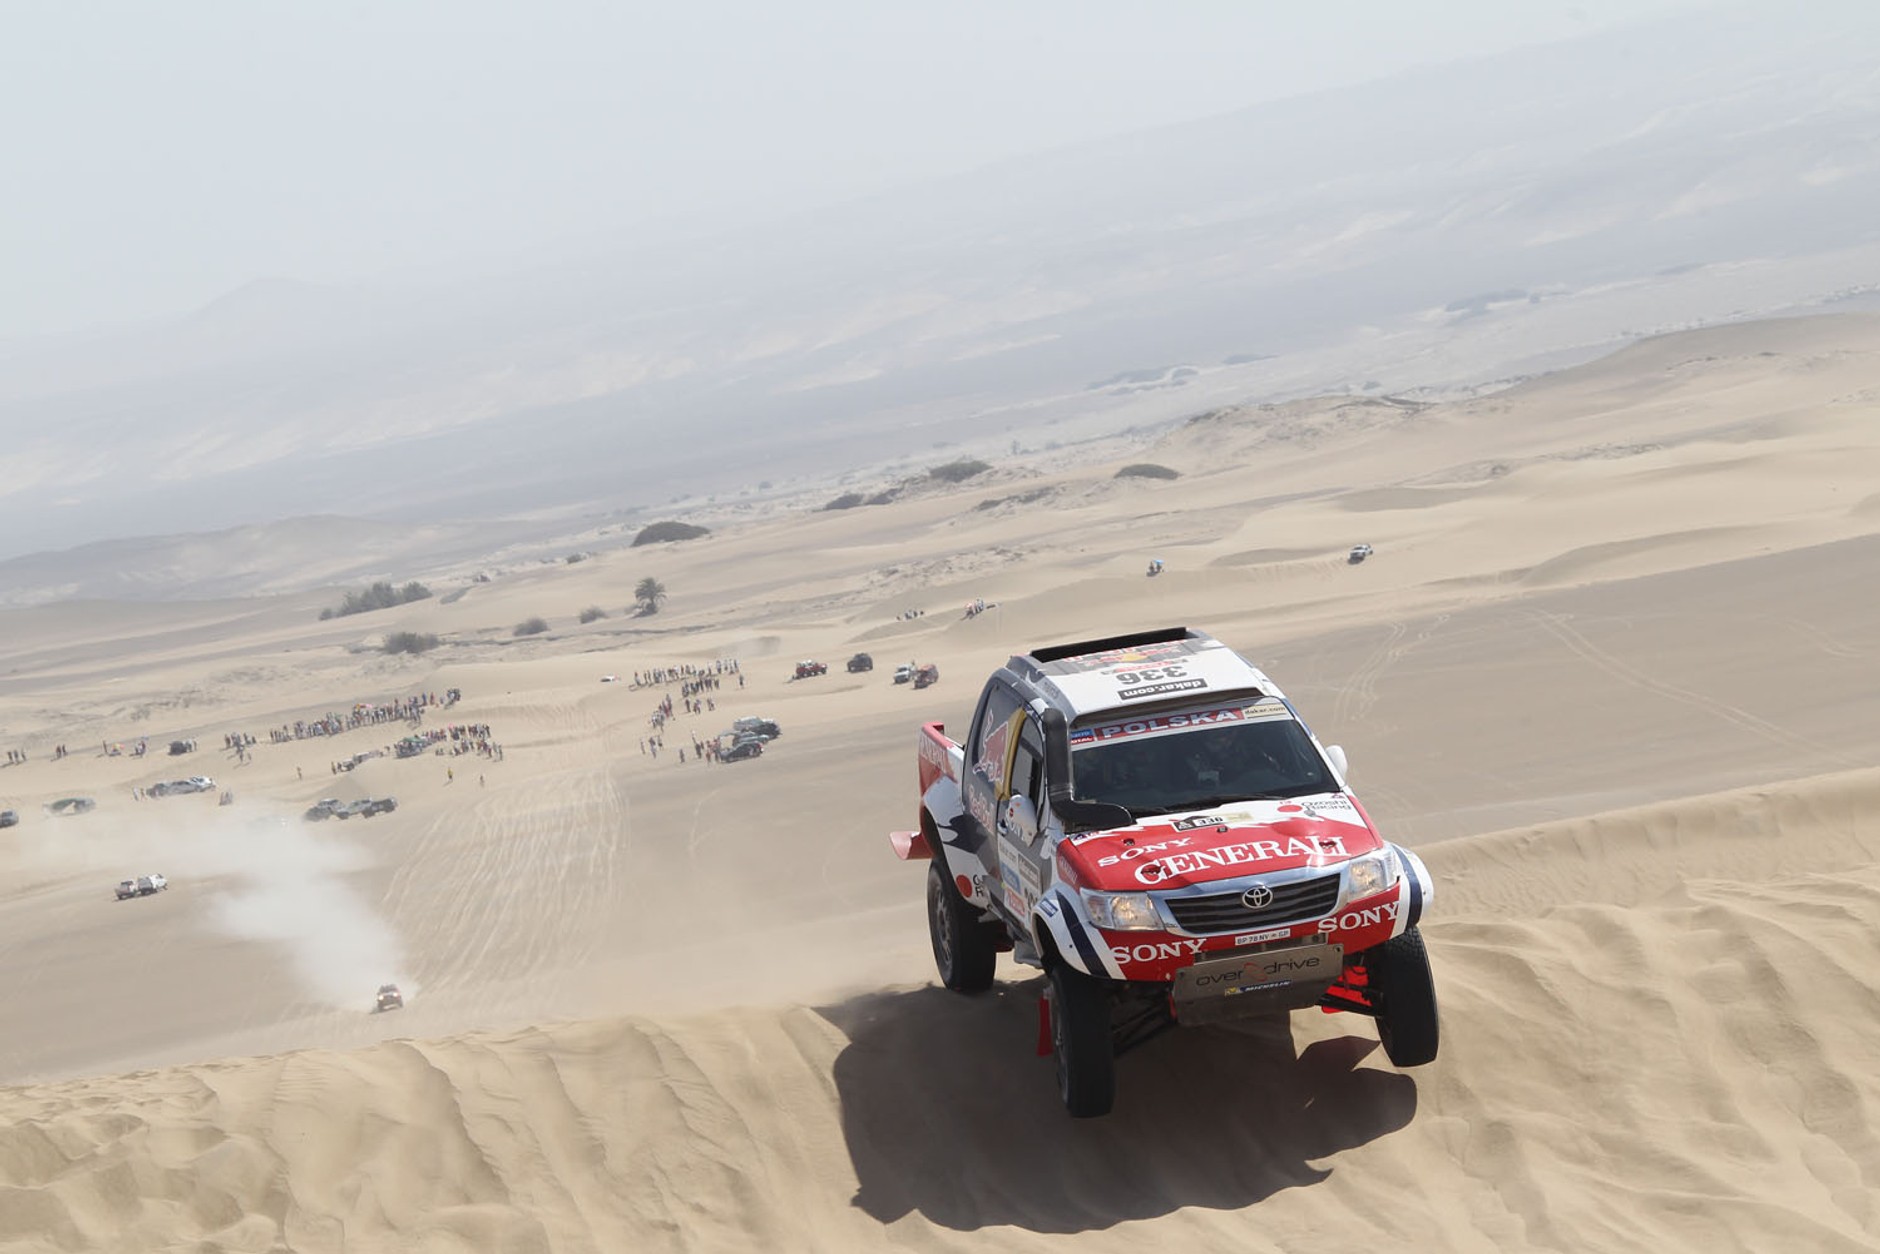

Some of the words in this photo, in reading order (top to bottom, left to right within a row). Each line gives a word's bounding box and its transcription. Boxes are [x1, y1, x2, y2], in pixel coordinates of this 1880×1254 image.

[1116, 666, 1188, 685] 336
[1123, 681, 1202, 697] dakar.com
[1102, 710, 1238, 738] POLSKA
[1097, 837, 1192, 867] SONY
[1134, 836, 1352, 885] GENERALI
[1318, 901, 1400, 934] SONY
[1110, 938, 1207, 965] SONY
[1196, 970, 1243, 986] over
[1264, 957, 1320, 975] drive
